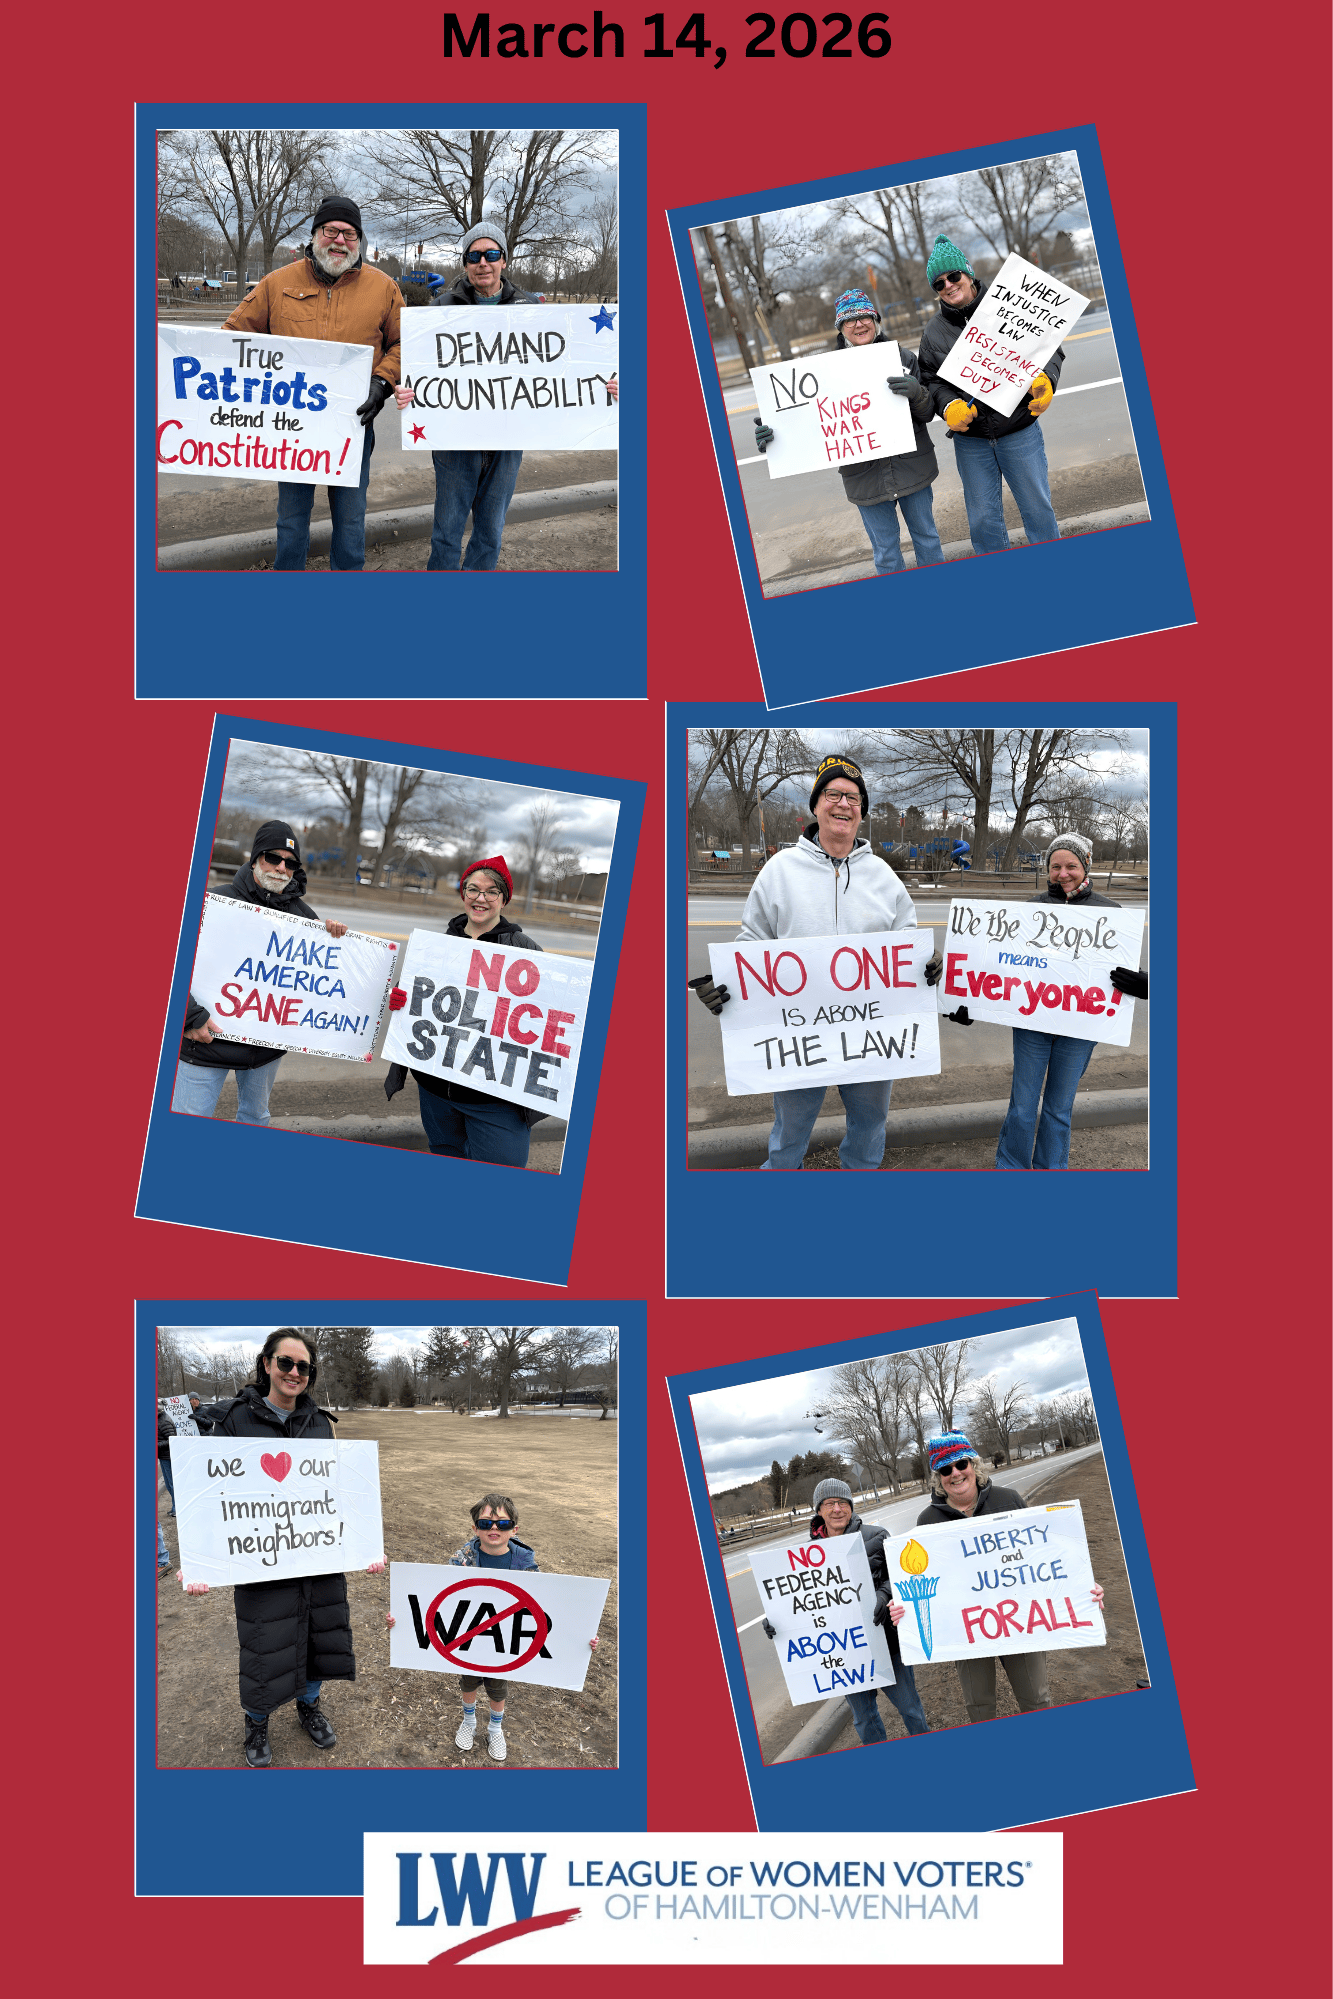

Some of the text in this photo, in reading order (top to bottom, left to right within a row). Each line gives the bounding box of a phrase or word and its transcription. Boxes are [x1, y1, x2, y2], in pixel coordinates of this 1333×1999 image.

[991, 285, 1067, 329] INJUSTICE
[1021, 274, 1070, 307] WHEN
[996, 307, 1044, 337] BECOMES
[998, 322, 1024, 341] LAW
[232, 339, 284, 371] True
[435, 330, 566, 368] DEMAND
[965, 326, 1044, 378] RESISTANCE
[173, 356, 328, 412] Patriots
[960, 366, 1001, 393] DUTY
[970, 352, 1026, 388] BECOMES
[404, 371, 617, 410] ACCOUNTABILITY
[769, 367, 819, 409] NO
[210, 405, 303, 432] defend the
[815, 391, 872, 423] KINGS
[821, 416, 863, 439] WAR
[157, 420, 351, 476] Constitution!
[825, 431, 882, 462] HATE
[238, 903, 254, 911] LAW
[950, 905, 1118, 960] We the People
[266, 931, 341, 971] MAKE
[998, 951, 1048, 970] means
[234, 957, 347, 999] AMERICA
[466, 948, 541, 997] NO
[734, 943, 917, 1001] NO ONE
[944, 952, 1123, 1017] Everyone!
[214, 982, 370, 1036] SANE AGAIN!
[408, 976, 576, 1058] POLICE
[781, 1000, 884, 1027] IS ABOVE
[406, 1020, 562, 1102] STATE
[753, 1023, 920, 1069] THE LAW!
[207, 1456, 336, 1477] we our
[220, 1489, 337, 1530] immigrant
[227, 1521, 344, 1567] neighbors!
[786, 1544, 826, 1571] NO
[960, 1524, 1049, 1559] LIBERTY
[1001, 1549, 1023, 1563] and
[762, 1566, 851, 1600] FEDERAL
[970, 1559, 1068, 1592] JUSTICE
[792, 1583, 863, 1615] AGENCY
[407, 1594, 553, 1659] WAR
[812, 1614, 826, 1629] is
[786, 1626, 868, 1662] ABOVE
[812, 1659, 876, 1694] LAW!
[820, 1654, 845, 1670] the
